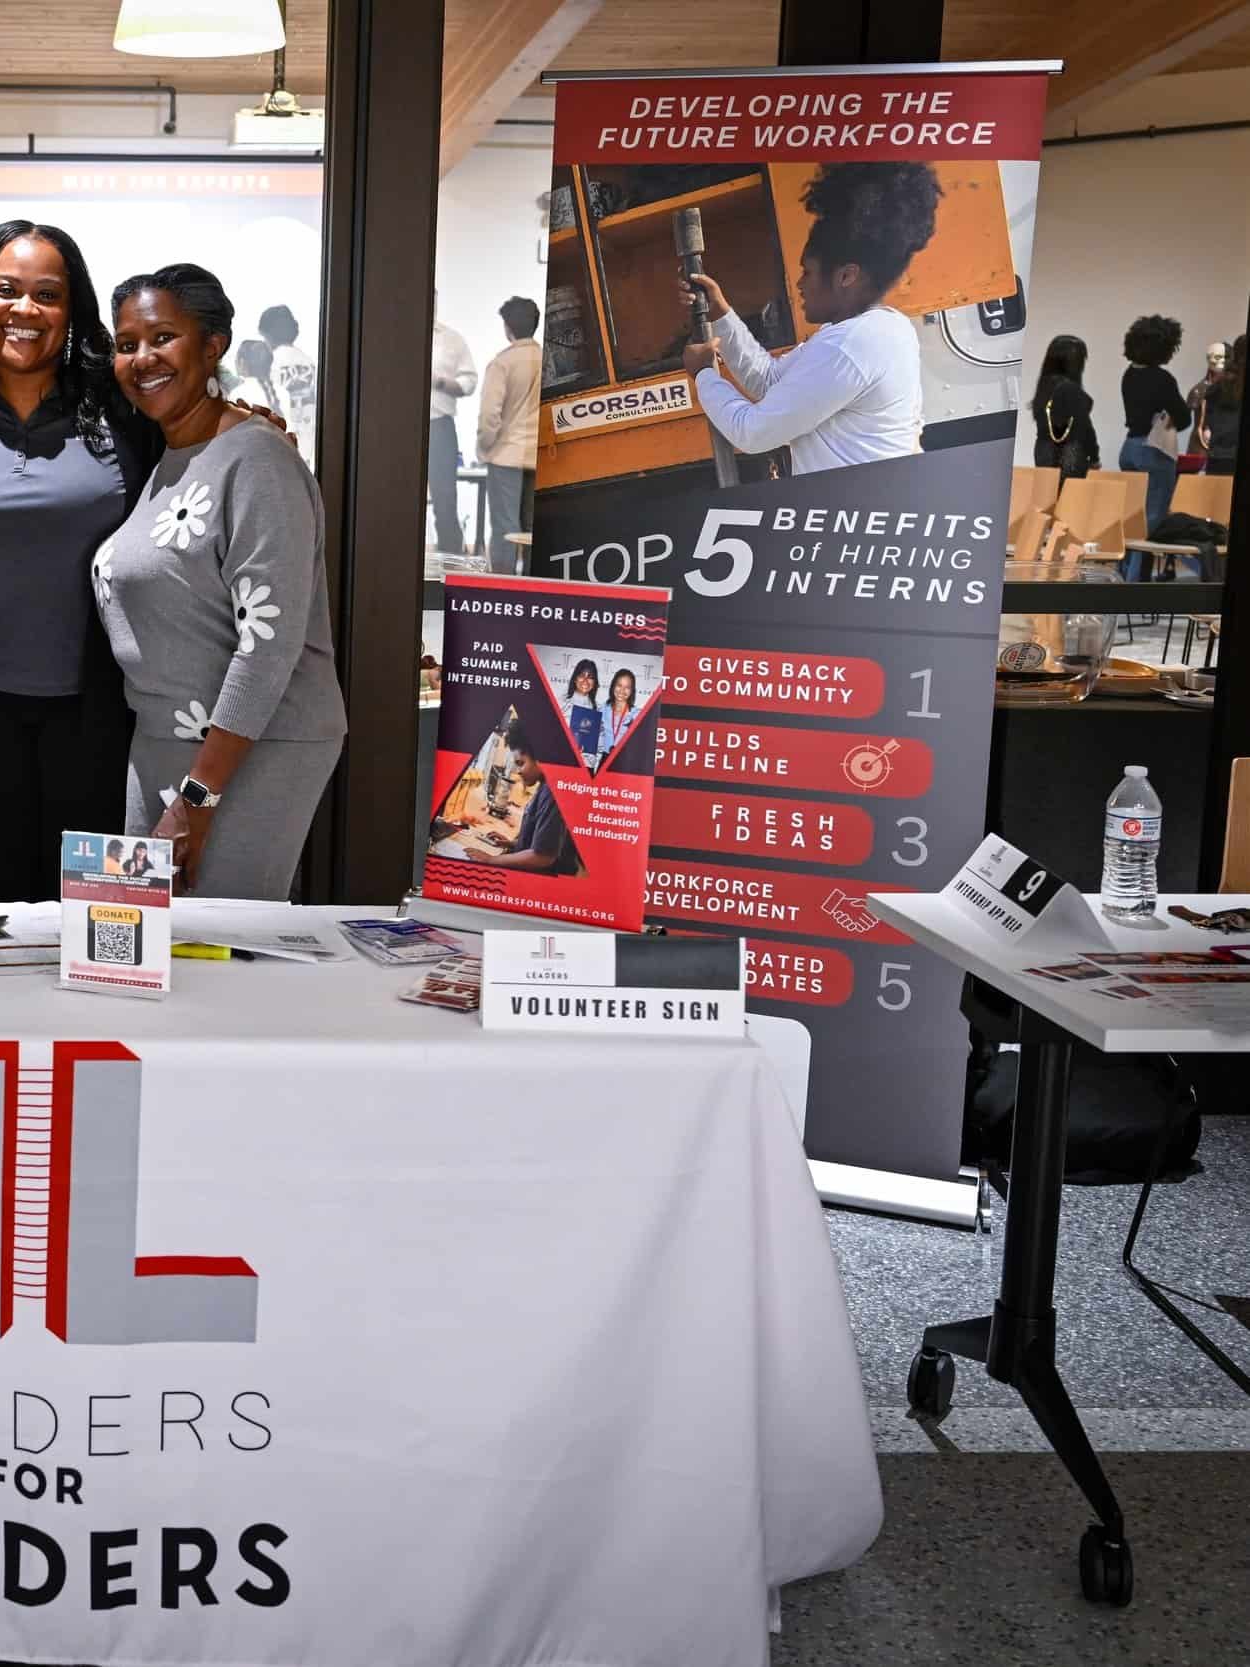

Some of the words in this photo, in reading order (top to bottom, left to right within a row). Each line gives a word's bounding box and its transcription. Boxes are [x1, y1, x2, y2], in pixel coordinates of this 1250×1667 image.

[629, 92, 864, 119] DEVELOPING
[880, 91, 953, 115] THE
[598, 125, 738, 149] FUTURE
[752, 121, 997, 149] WORKFORCE
[572, 385, 686, 418] CORSAIR
[605, 404, 664, 421] CONSULTING
[667, 399, 687, 408] LLC
[772, 507, 994, 541] BENEFITS
[550, 534, 674, 585] TOP
[684, 508, 764, 597] 5
[789, 541, 823, 562] of
[840, 544, 973, 571] HIRING
[765, 569, 988, 605] INTERNS
[451, 599, 525, 617] LADDERS
[530, 605, 564, 620] FOR
[570, 608, 647, 627] LEADERS
[473, 641, 504, 653] PAID
[461, 657, 518, 672] SUMMER
[698, 656, 770, 677] GIVES
[781, 662, 847, 682] BACK
[447, 672, 531, 690] INTERNSHIPS
[661, 675, 688, 691] TO
[699, 678, 854, 705] COMMUNITY
[906, 668, 942, 719] 1
[656, 727, 761, 750] BUILDS
[654, 748, 789, 775] PIPELINE
[556, 780, 599, 797] Bridging
[600, 785, 618, 797] the
[620, 788, 642, 801] Gap
[587, 813, 640, 828] Education
[592, 799, 638, 814] Between
[711, 804, 834, 832] FRESH
[573, 825, 592, 836] and
[593, 827, 639, 844] Industry
[715, 823, 833, 850] IDEAS
[891, 816, 928, 867] 3
[1018, 870, 1047, 901] 9
[96, 909, 135, 920] DONATE
[442, 885, 615, 922] WWW.LADDERSFORLEADERS.ORG
[954, 879, 992, 910] INTERNSHIP
[987, 904, 1006, 921] APP
[1001, 914, 1023, 933] HELP
[526, 971, 568, 980] LEADERS
[876, 962, 912, 1012] 5
[511, 995, 647, 1020] VOLUNTEER
[662, 999, 720, 1021] SIGN
